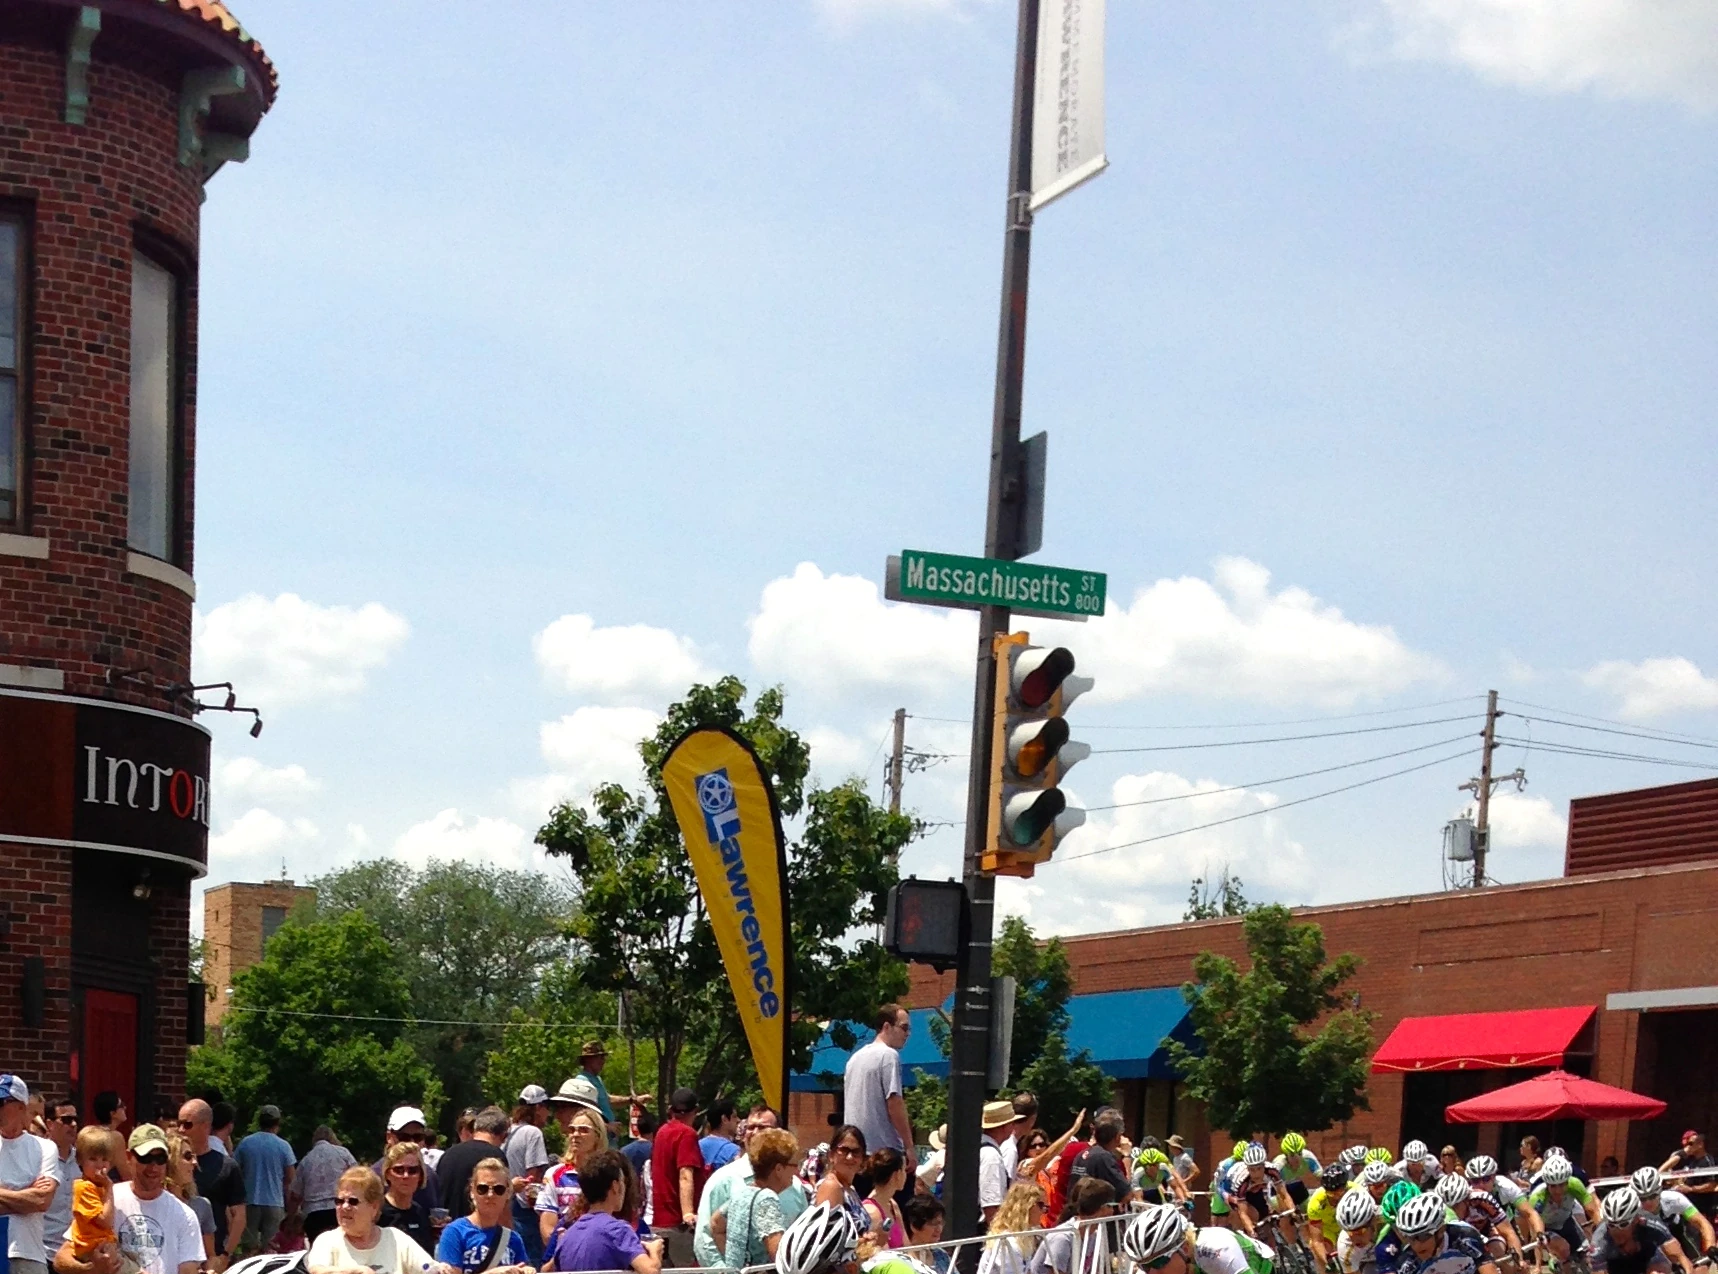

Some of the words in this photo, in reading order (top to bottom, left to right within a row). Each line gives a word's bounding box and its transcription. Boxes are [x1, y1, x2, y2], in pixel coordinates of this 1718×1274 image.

[906, 556, 1070, 606] Massachusetts
[1081, 575, 1097, 592] ST
[1075, 593, 1101, 612] 800
[711, 806, 780, 1020] Lawrence
